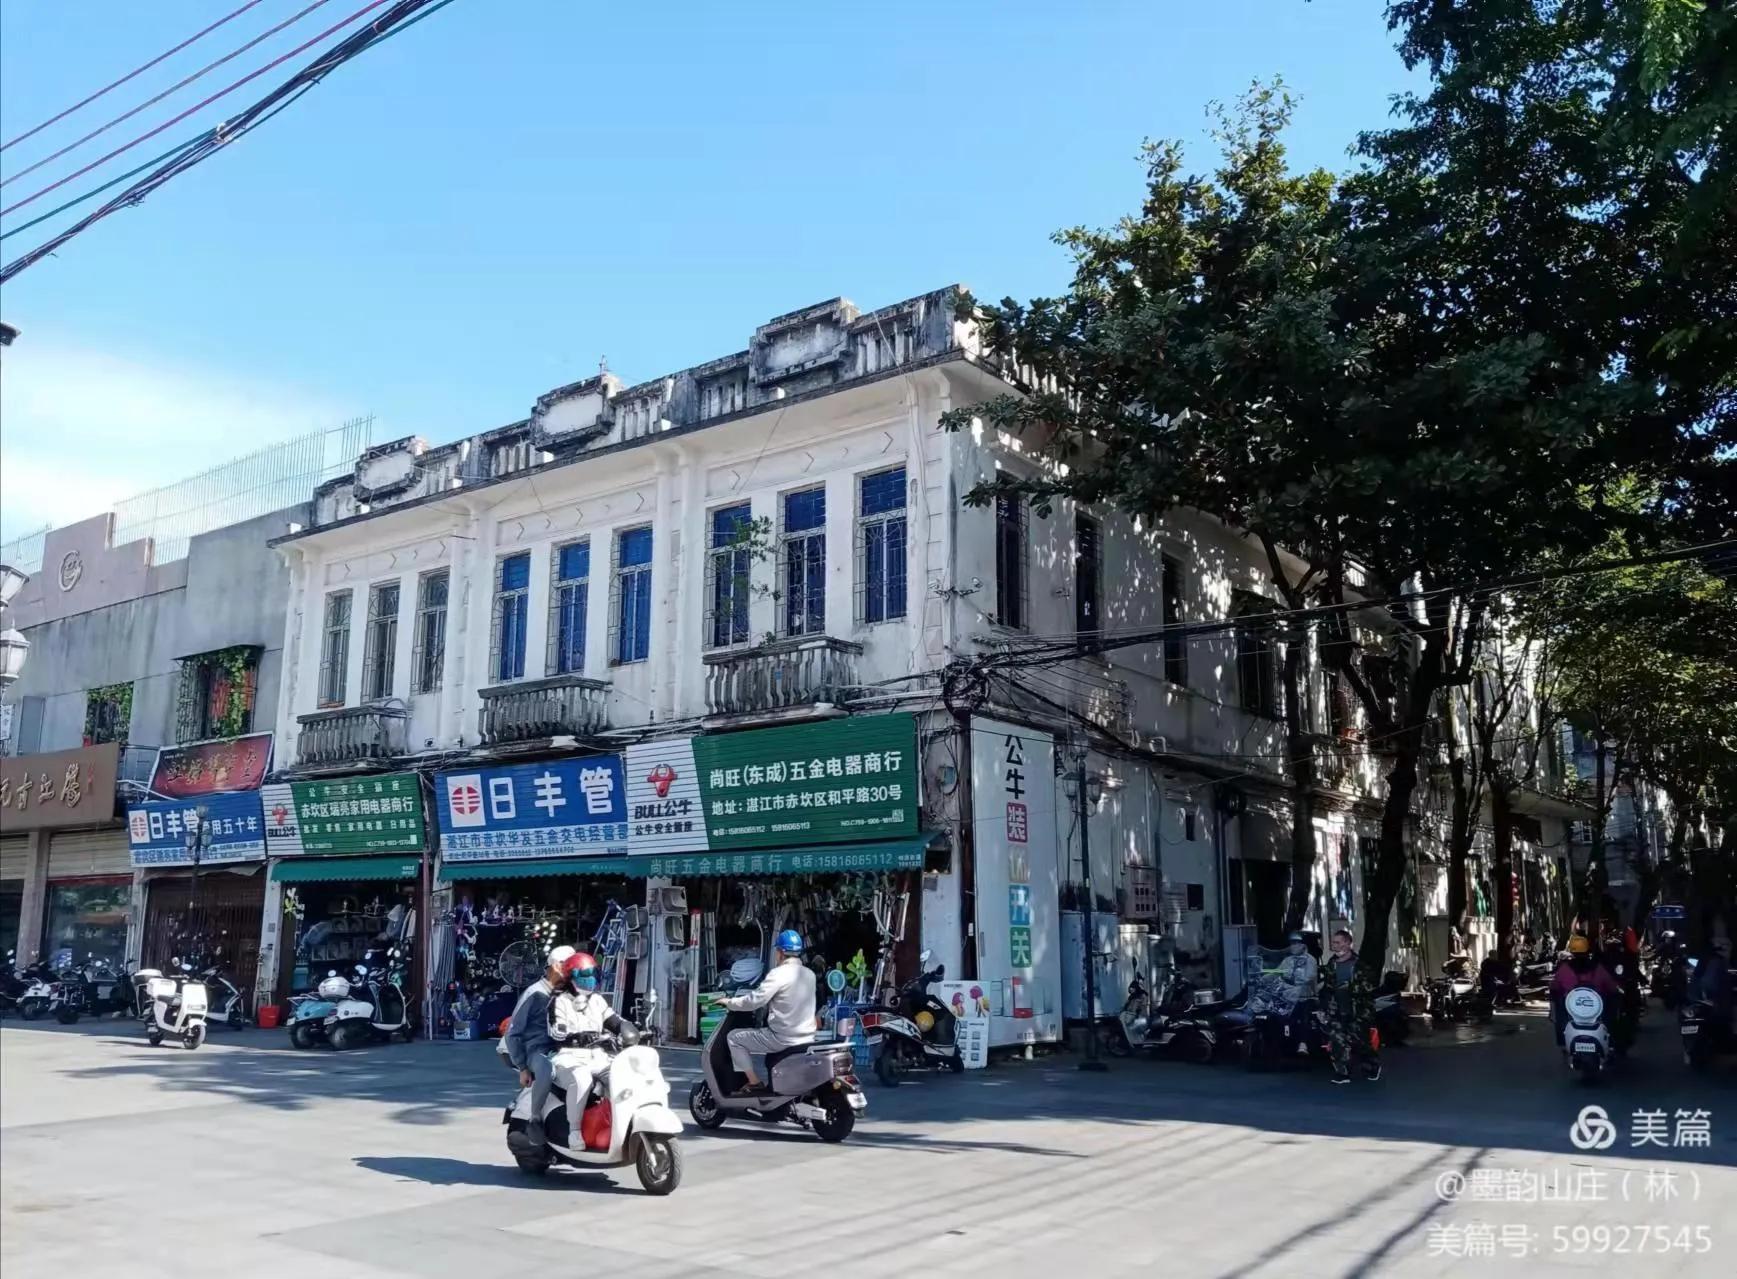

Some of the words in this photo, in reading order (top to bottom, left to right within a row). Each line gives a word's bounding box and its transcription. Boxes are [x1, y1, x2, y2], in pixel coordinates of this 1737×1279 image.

[489, 766, 613, 819] 日丰管
[709, 751, 902, 789] 尚旺(东成)五金电器商行
[301, 796, 414, 818] 赤坎区瑞亮家用电器商行
[1005, 735, 1032, 965] 公牛装开关
